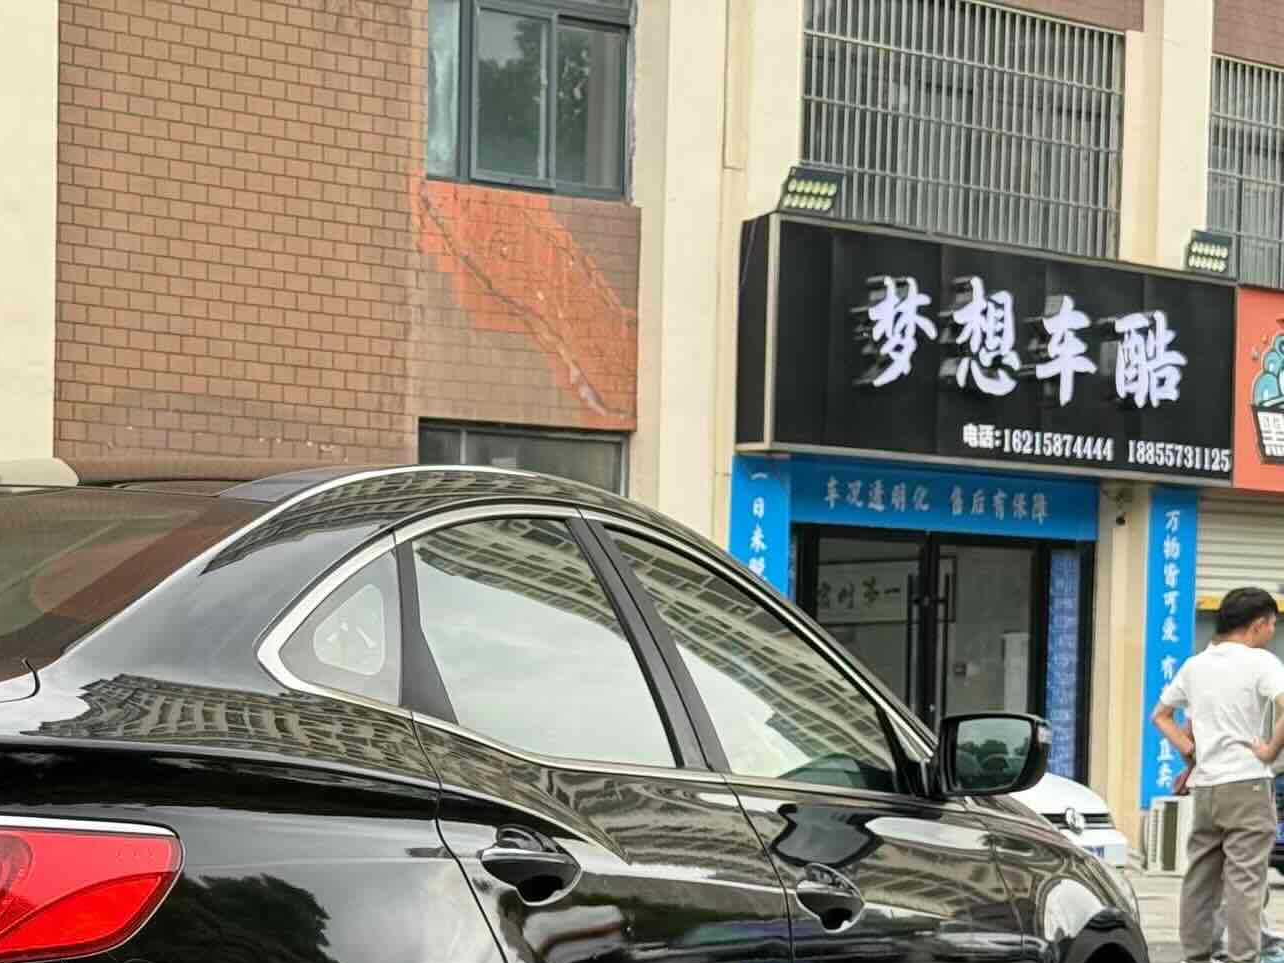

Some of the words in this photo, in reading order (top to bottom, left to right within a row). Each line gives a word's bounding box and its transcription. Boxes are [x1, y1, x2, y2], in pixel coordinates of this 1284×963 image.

[864, 276, 1187, 409] 梦想车酷
[1128, 439, 1232, 472] 18855731125
